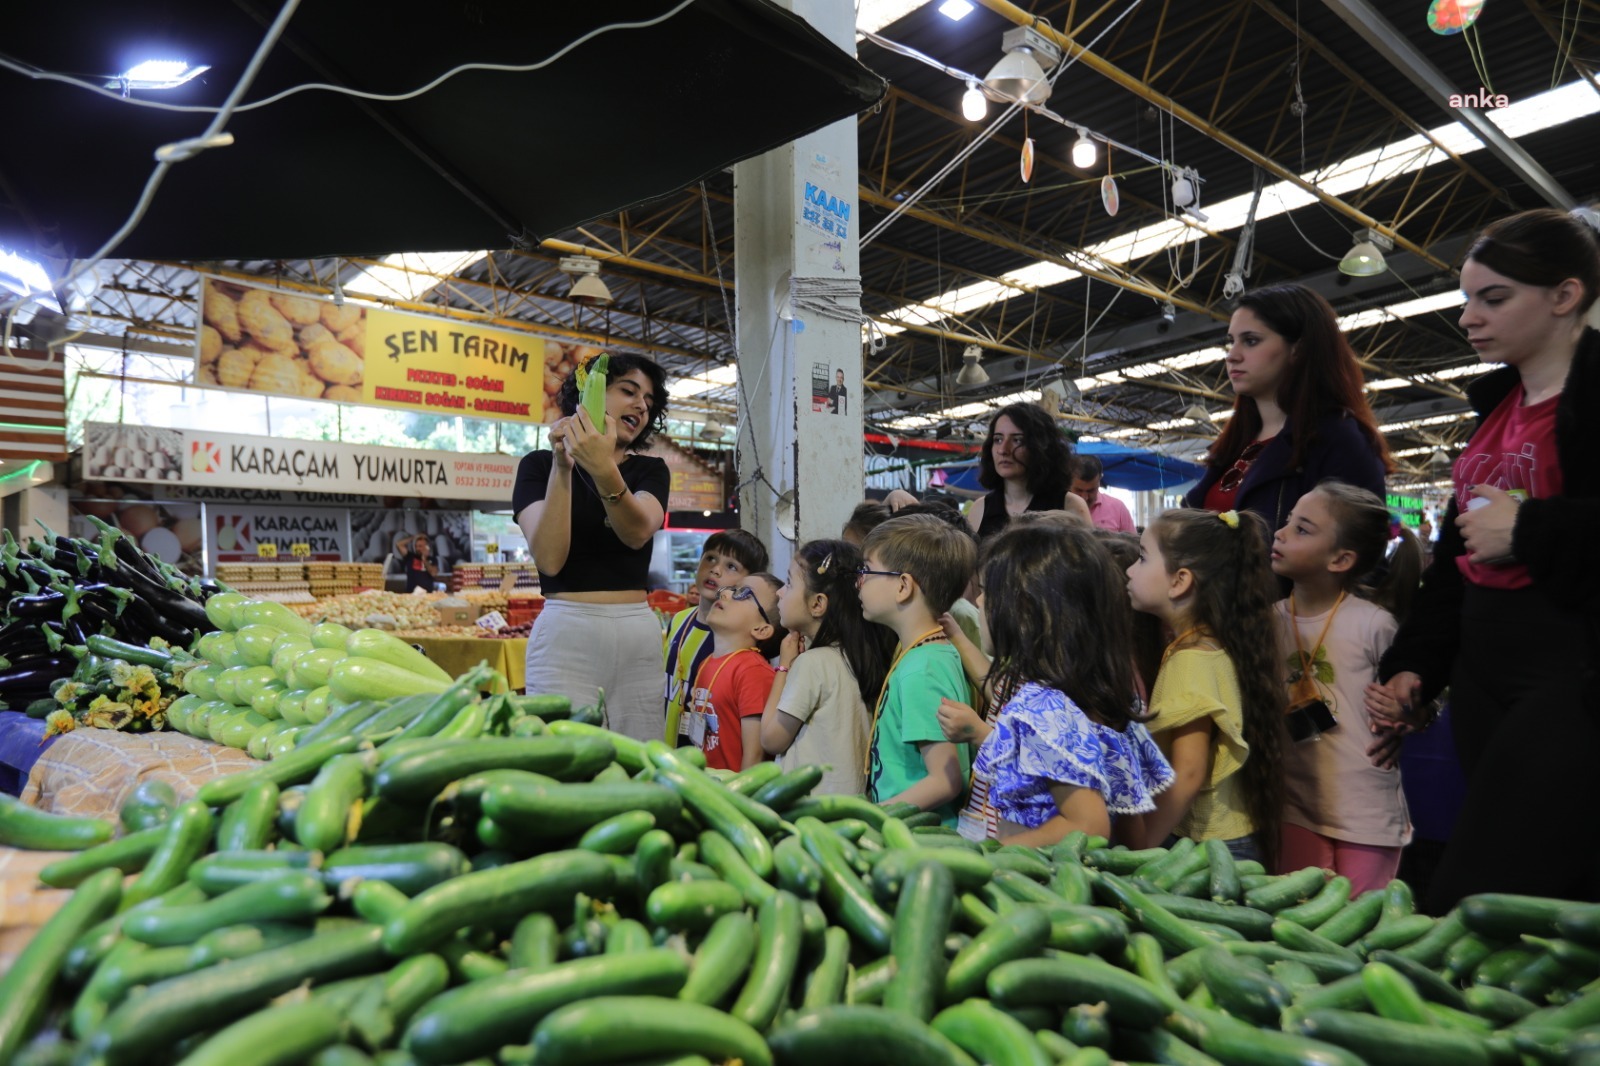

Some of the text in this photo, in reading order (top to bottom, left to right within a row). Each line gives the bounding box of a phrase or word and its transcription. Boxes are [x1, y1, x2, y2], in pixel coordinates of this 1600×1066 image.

[804, 182, 850, 221] KAAN
[384, 330, 530, 373] ŞEN TARIM
[407, 368, 457, 387] PATATES
[466, 375, 504, 392] SOĞAN
[375, 386, 422, 404] KIRMIZI
[425, 391, 465, 409] SOĞAN
[474, 398, 530, 416] SARIMSAK
[231, 444, 448, 486] KARAÇAM YUMURTA
[454, 461, 514, 475] TOPTAN VE PERAKENDE
[455, 476, 512, 488] 0532 352 33 47
[254, 516, 338, 536] KARAÇAM
